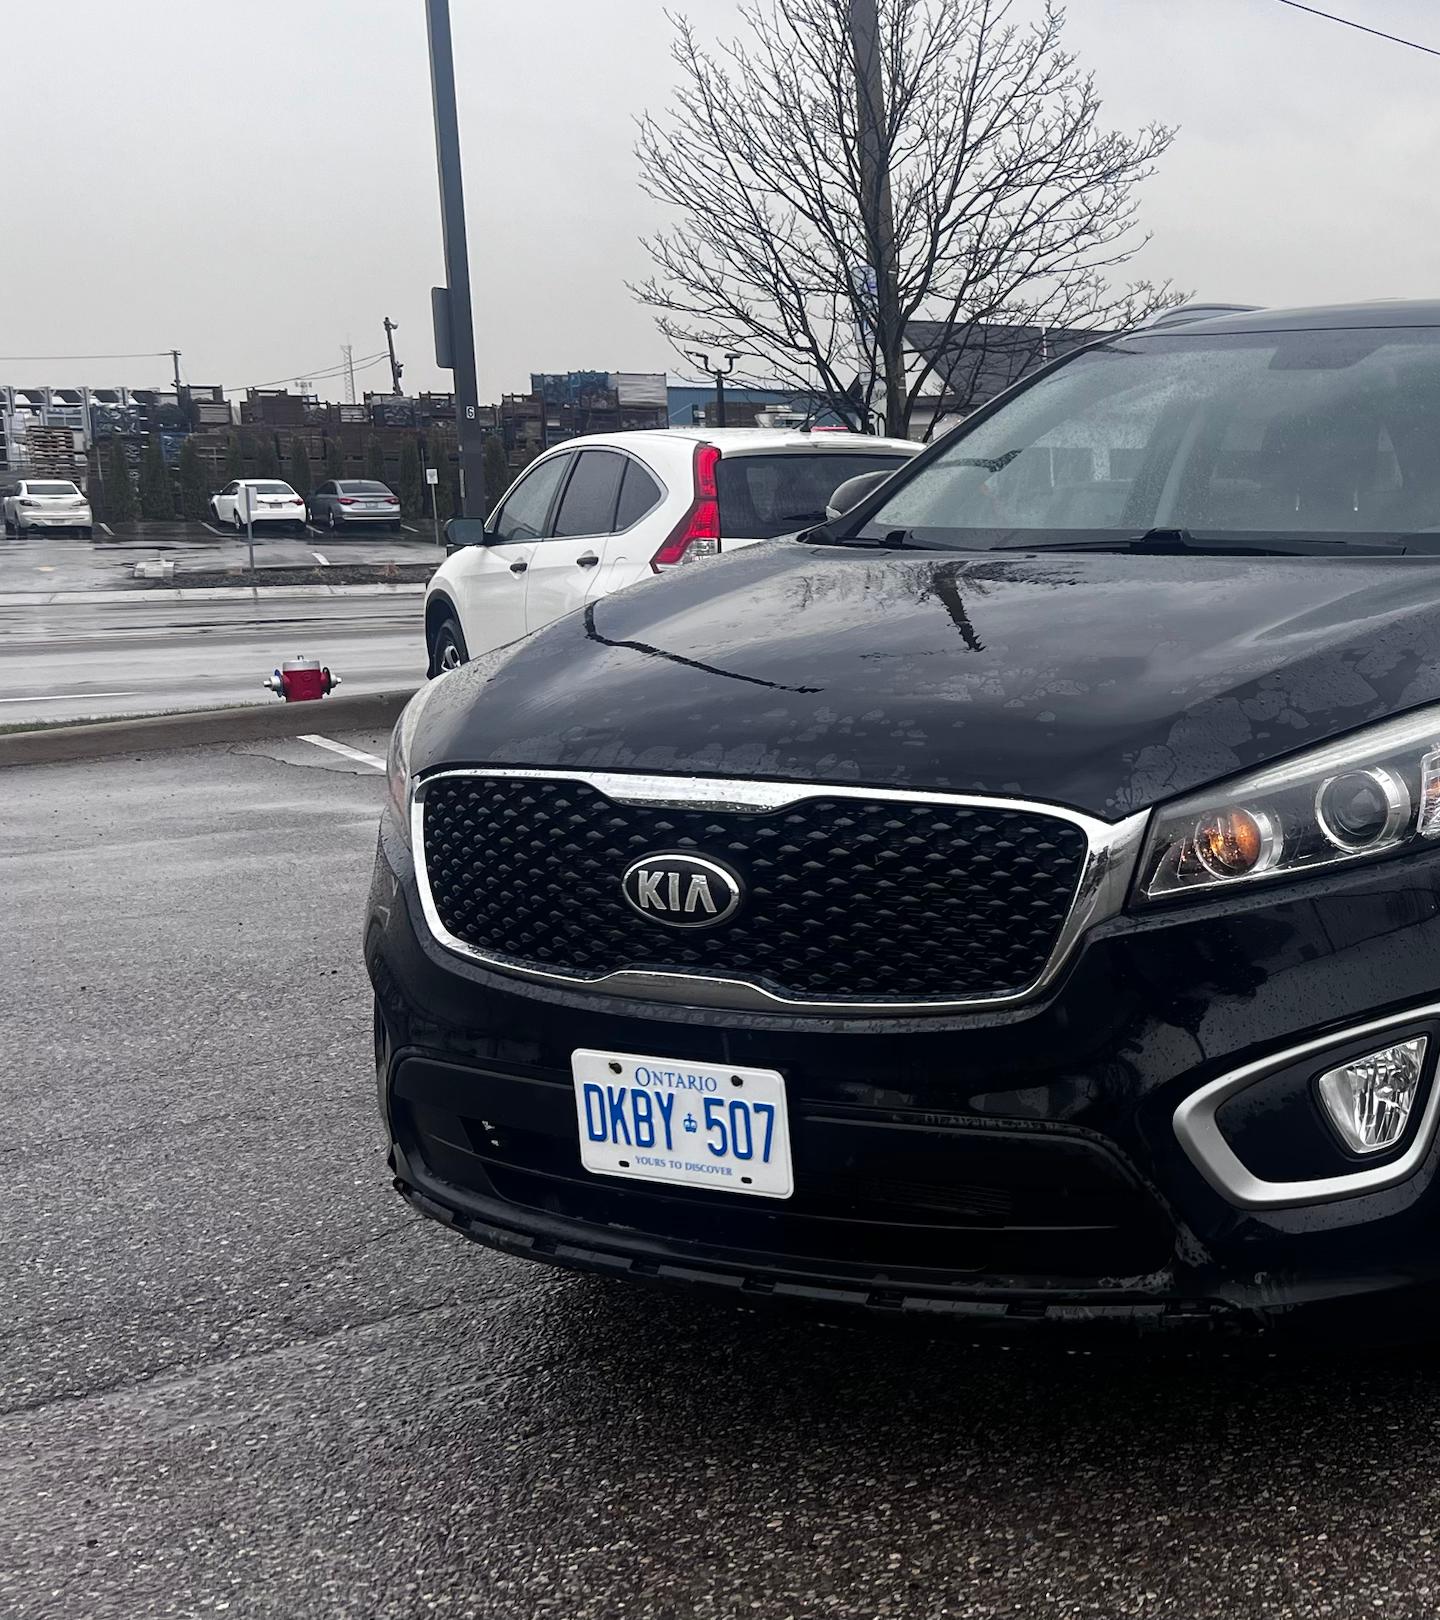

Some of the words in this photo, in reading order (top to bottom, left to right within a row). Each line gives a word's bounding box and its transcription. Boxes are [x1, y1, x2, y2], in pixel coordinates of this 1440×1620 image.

[638, 870, 717, 913] KIA
[635, 1067, 717, 1093] ONTARIO
[584, 1083, 674, 1151] DKBY
[704, 1097, 775, 1164] 507
[635, 1156, 666, 1168] YOURS
[669, 1160, 682, 1170] TO
[685, 1162, 733, 1176] DISCOVER
